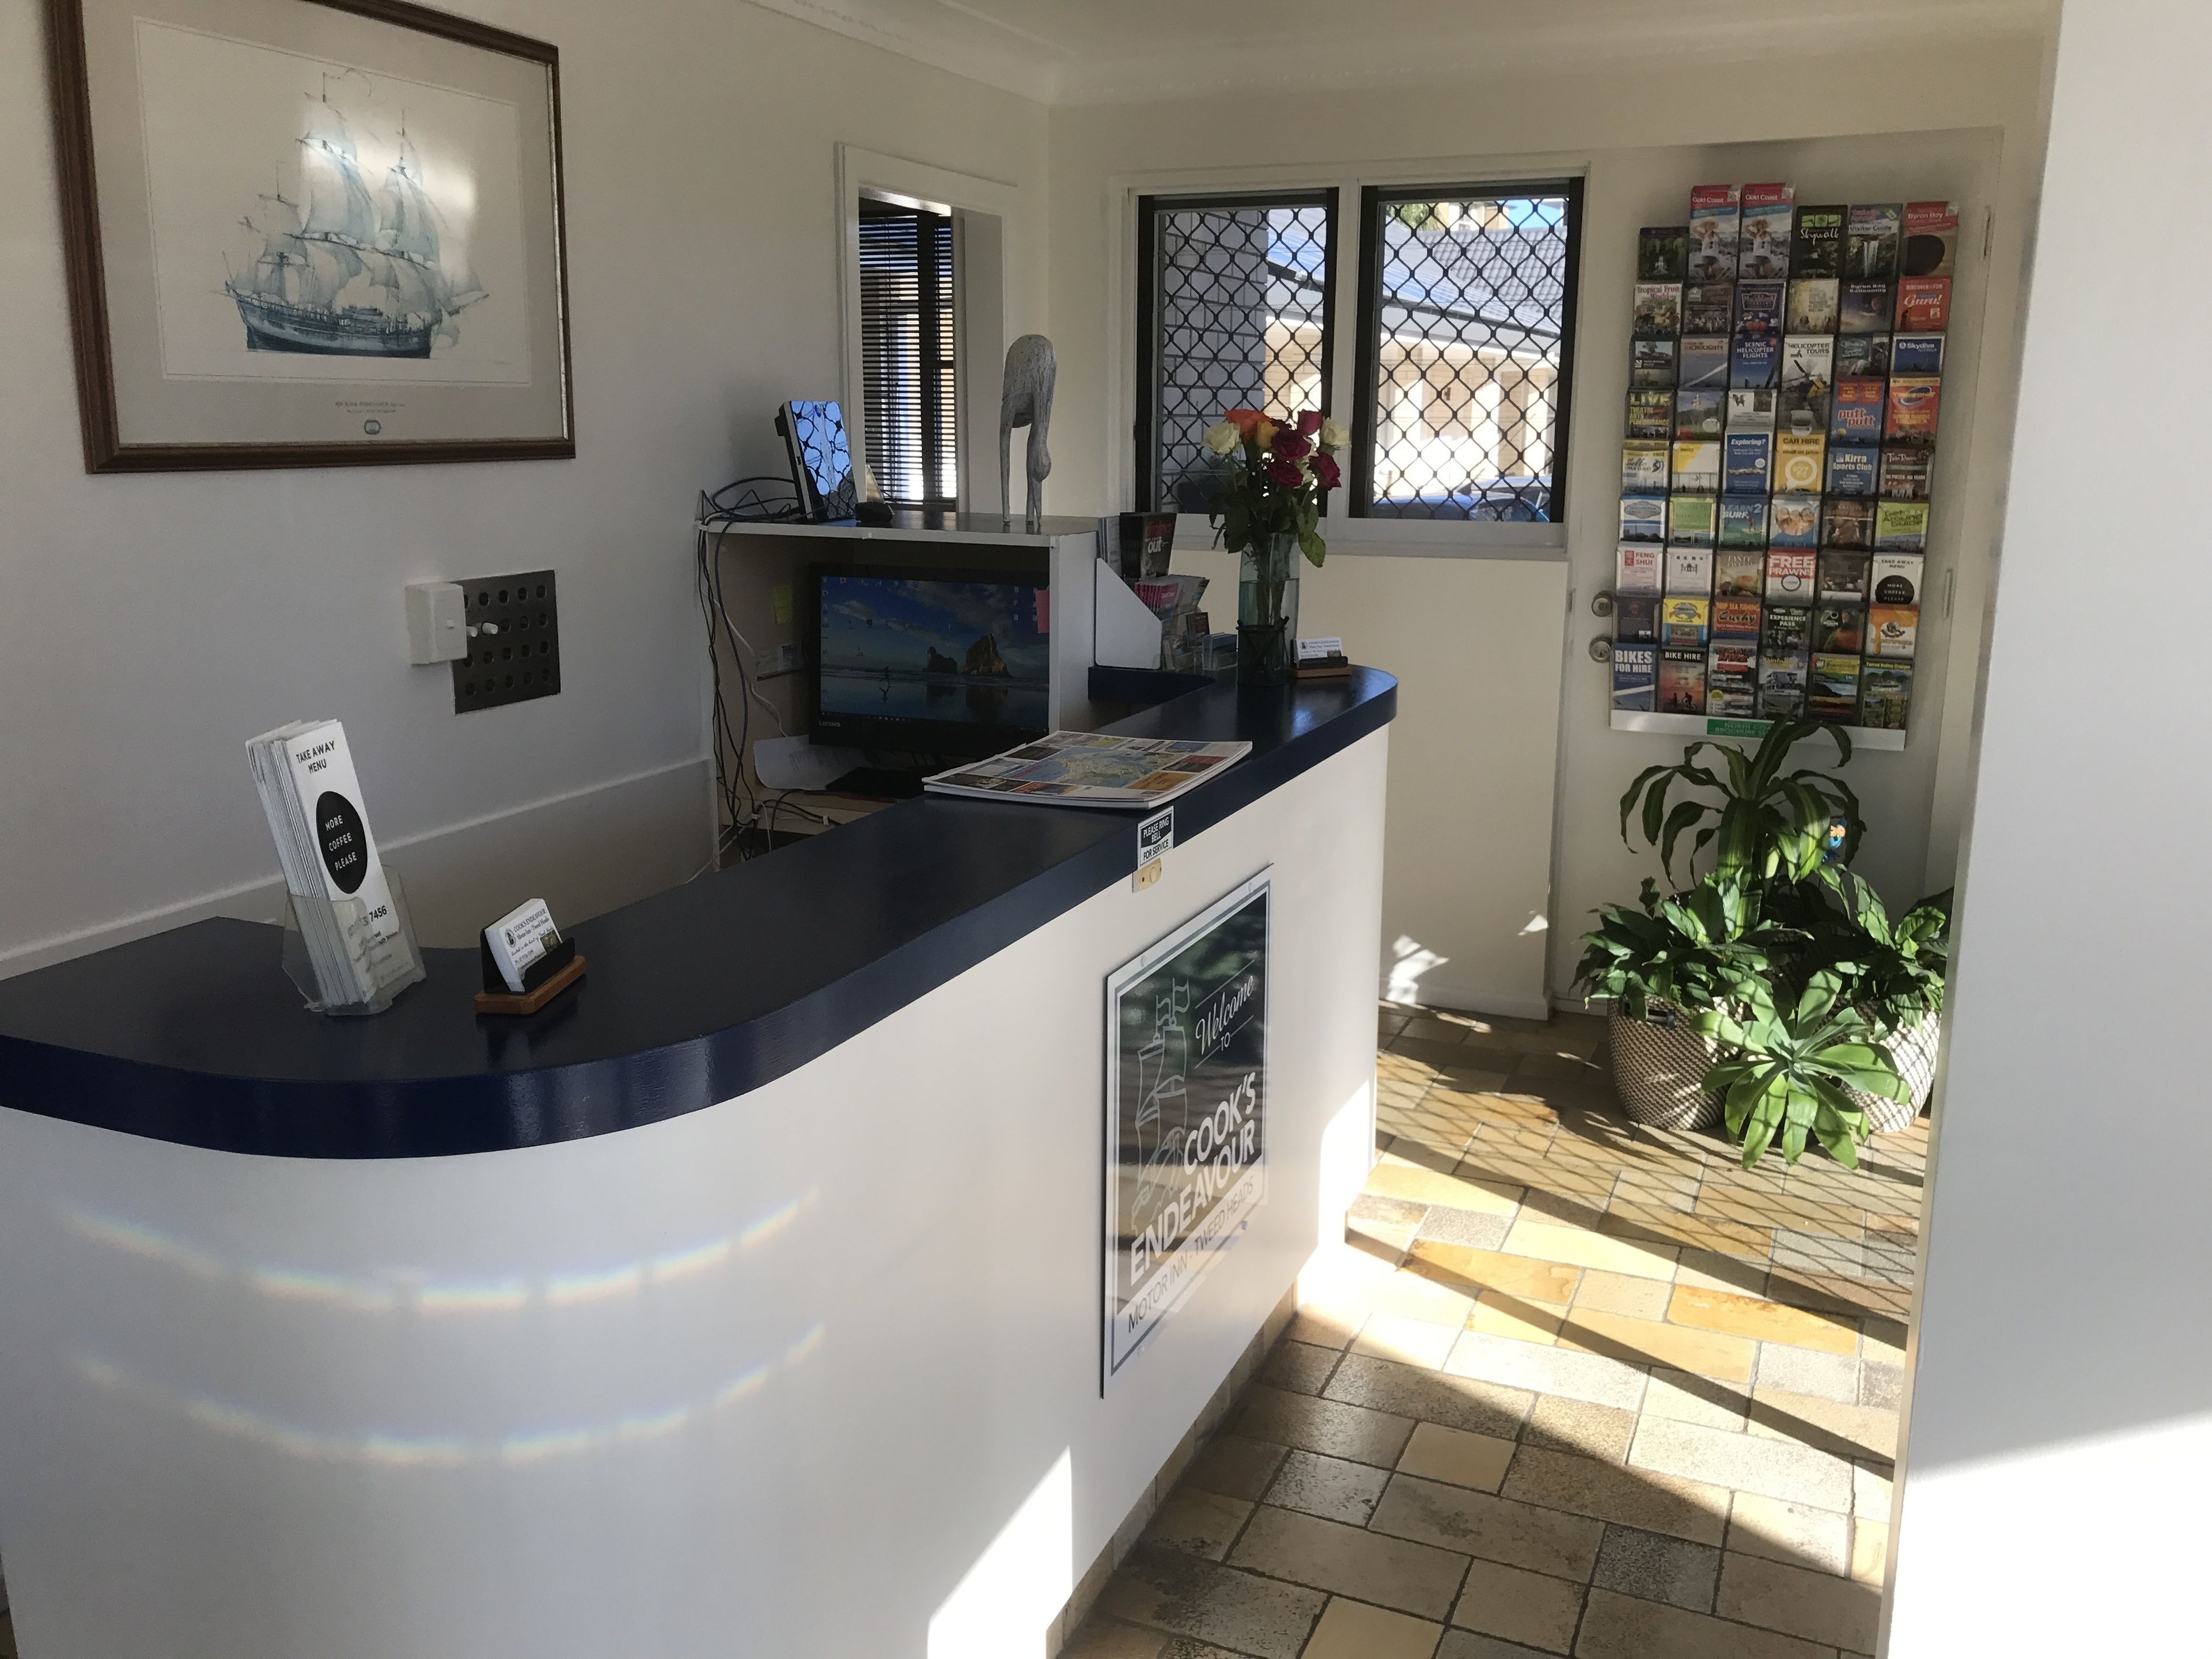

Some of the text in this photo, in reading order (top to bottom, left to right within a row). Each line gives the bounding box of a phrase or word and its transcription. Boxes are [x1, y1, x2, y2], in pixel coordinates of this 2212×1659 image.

[1800, 228, 1839, 245] Skywalk
[1637, 286, 1662, 294] Tropical
[1730, 438, 1766, 446] Exploring?
[1833, 462, 1855, 470] Sports
[1844, 454, 1866, 463] Kirra
[1769, 555, 1815, 568] FREE
[1615, 650, 1652, 662] BIKES
[1683, 652, 1702, 660] HIRE
[1615, 664, 1652, 673] FOR HIRE
[296, 740, 335, 764] TAKE AWAY
[308, 759, 327, 774] MENU
[325, 815, 343, 831] MORE
[1143, 817, 1169, 839] PLEASE RING
[328, 832, 353, 851] COFFEE
[1151, 831, 1161, 843] BELL
[1143, 839, 1169, 861] FOR SERVICE
[335, 851, 357, 871] PLEASE
[369, 904, 387, 922] 7456
[1195, 975, 1254, 1055] Welcome
[1221, 1032, 1230, 1051] TO
[1184, 1071, 1256, 1175] COOK'S
[1131, 1119, 1255, 1286] ENDEAVOUR
[1128, 1274, 1168, 1333] MOTOR
[1170, 1249, 1188, 1287] INN
[1194, 1210, 1225, 1255] TWEED
[1226, 1175, 1254, 1221] HEADS
